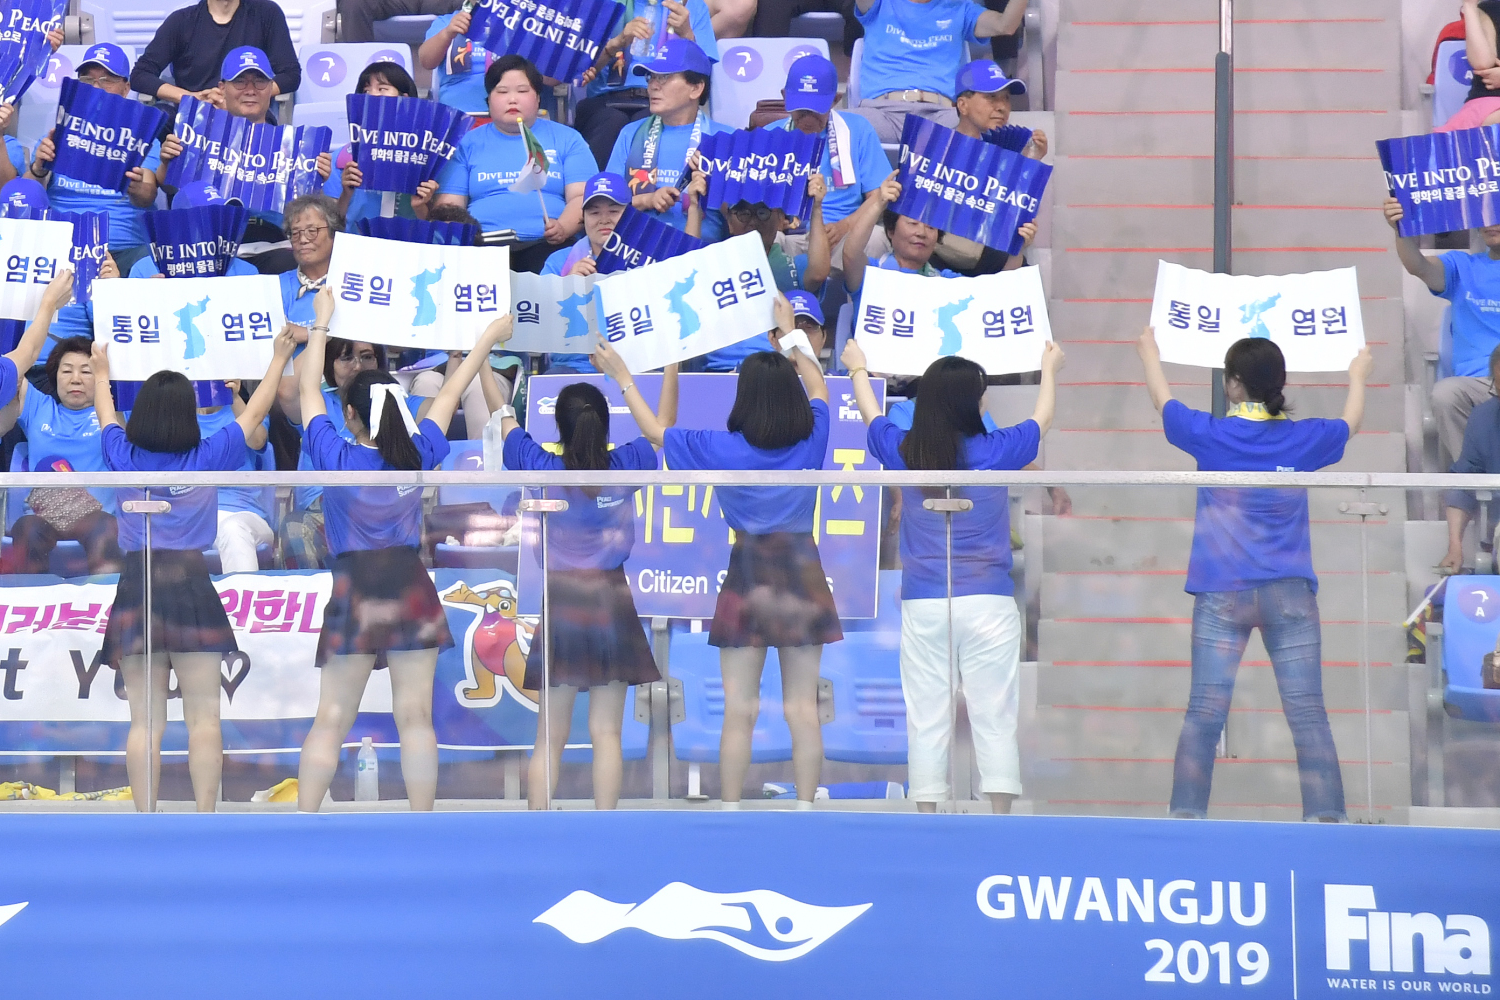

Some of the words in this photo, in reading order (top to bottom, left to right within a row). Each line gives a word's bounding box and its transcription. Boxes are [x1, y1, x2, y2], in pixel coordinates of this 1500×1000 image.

[915, 175, 943, 196] 평화의
[944, 186, 966, 205] 물결
[966, 195, 996, 213] 속으로
[933, 162, 978, 191] INTO
[984, 176, 1037, 213] PEACE
[6, 255, 56, 284] 염원
[341, 272, 392, 306] 통일
[454, 284, 497, 312] 염원
[604, 305, 653, 342] 통일
[712, 268, 766, 309] 염원
[113, 315, 159, 343] 통일
[222, 312, 273, 341] 염원
[517, 301, 539, 324] 일
[864, 305, 914, 337] 통일
[983, 305, 1033, 337] 염원
[1169, 300, 1220, 332] 통일
[1292, 307, 1347, 335] 염원
[839, 406, 863, 420] Fin
[637, 569, 708, 595] Citizen
[976, 875, 1266, 927] GWANGJU
[1144, 938, 1270, 986] 2019
[1326, 977, 1378, 990] WATER
[1383, 979, 1396, 991] IS
[1401, 980, 1432, 992] OUR
[1437, 981, 1492, 994] WORLD
